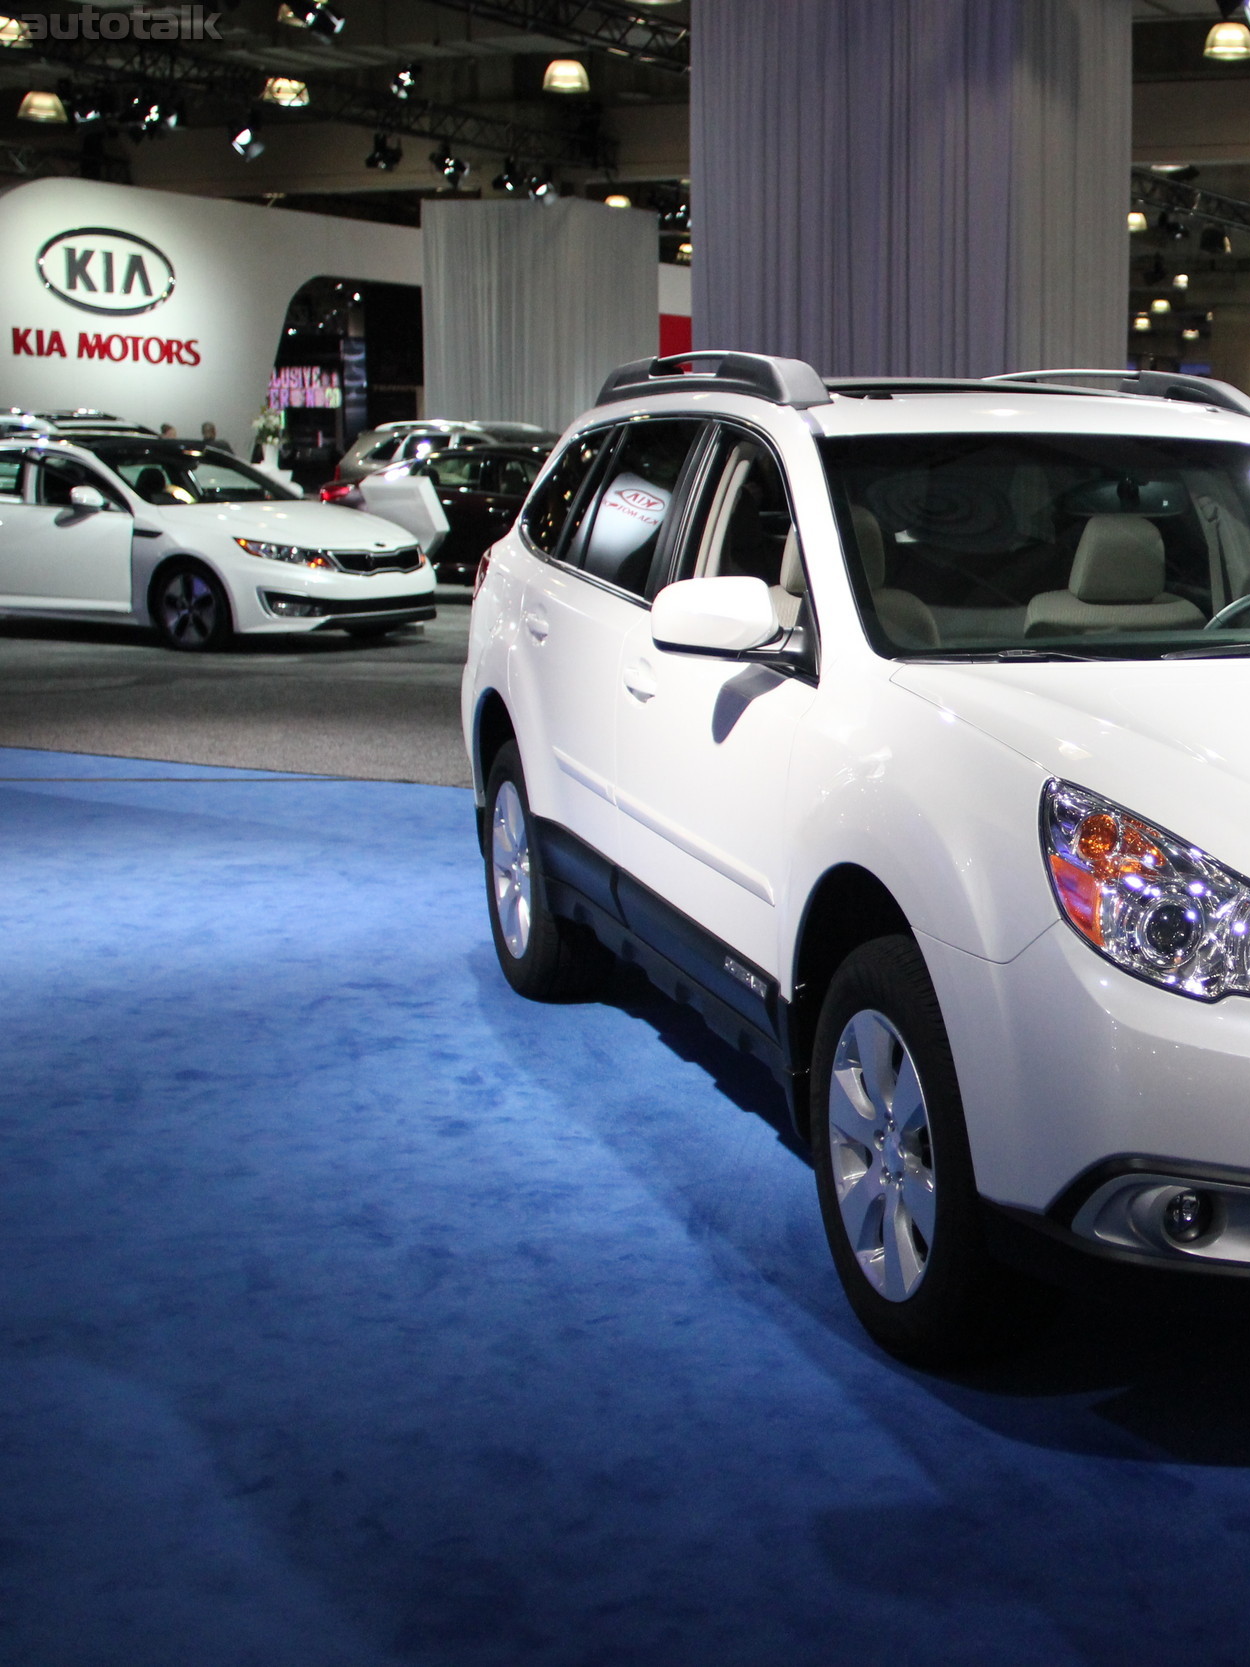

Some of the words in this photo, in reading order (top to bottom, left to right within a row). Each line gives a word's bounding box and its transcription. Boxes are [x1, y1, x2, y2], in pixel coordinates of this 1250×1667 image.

[62, 246, 153, 297] KIA
[12, 327, 67, 358] KIA
[77, 331, 201, 367] MOTORS
